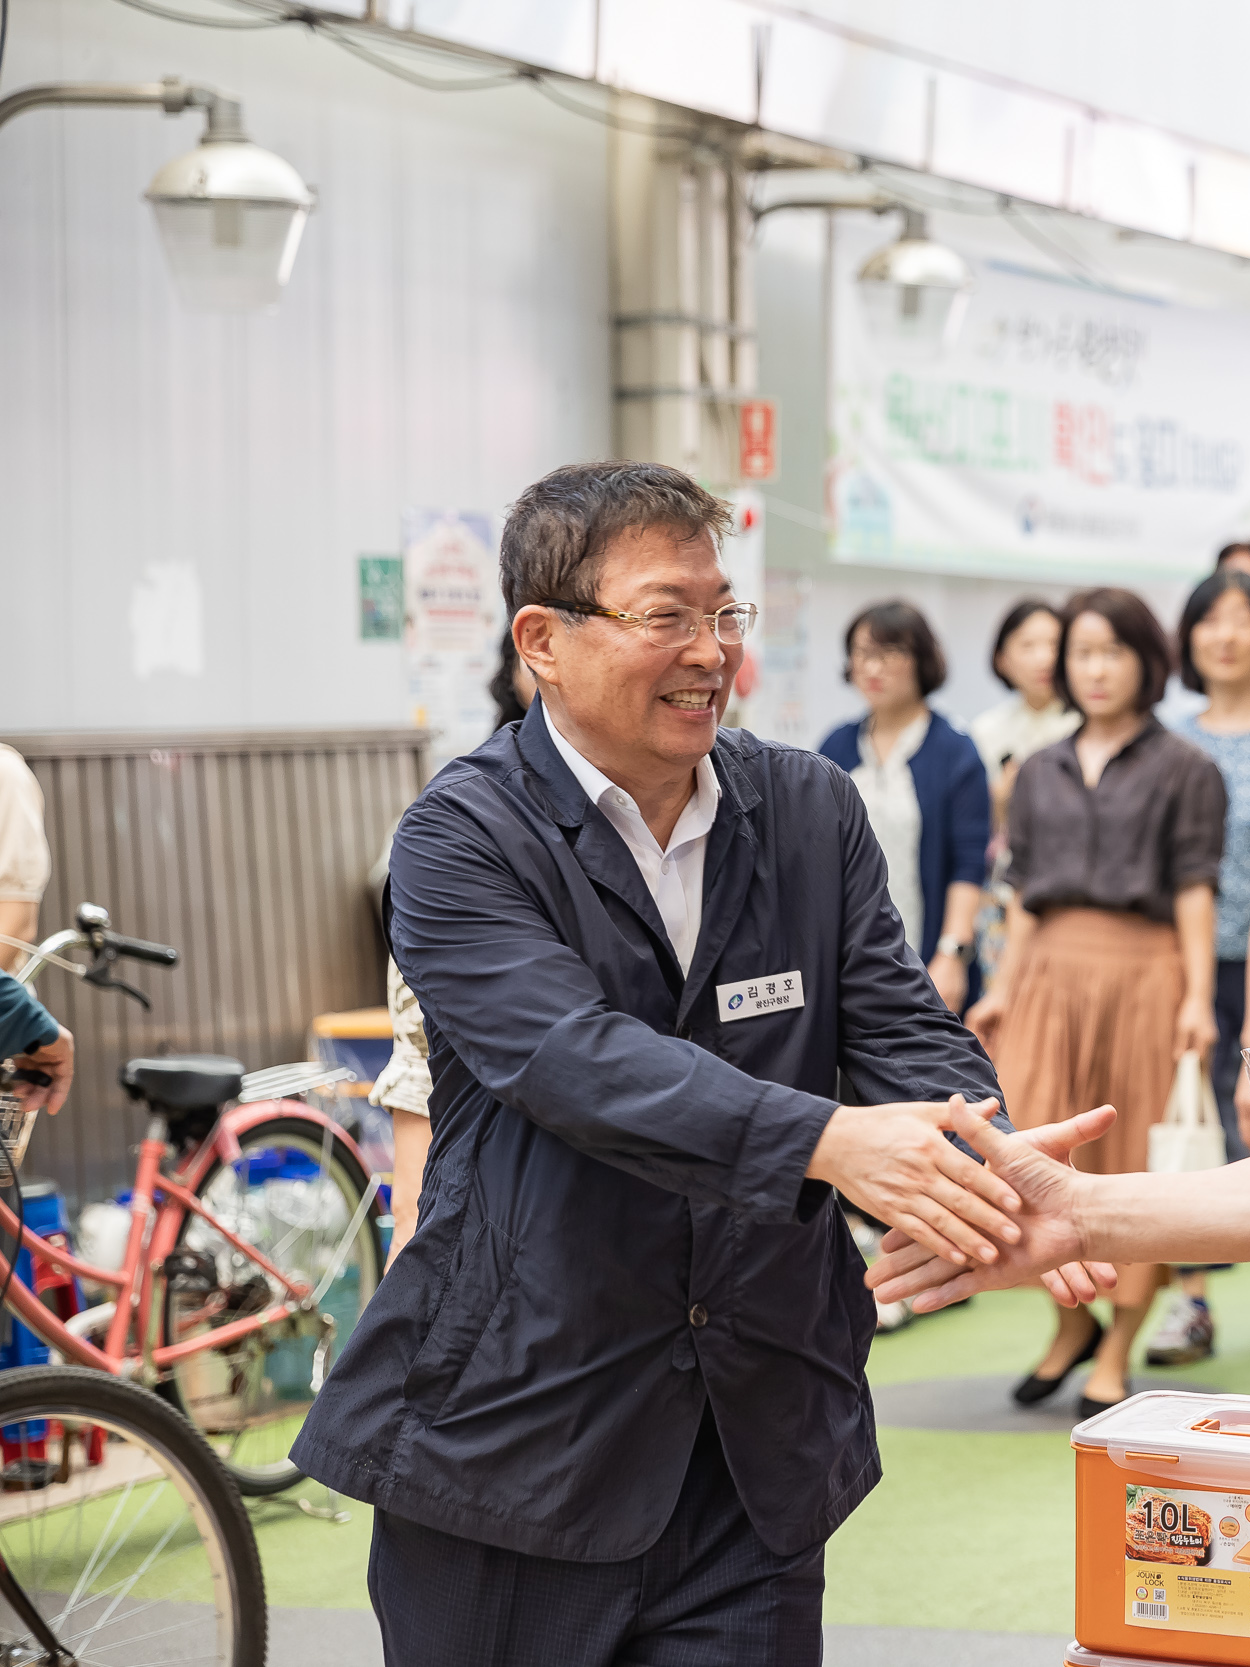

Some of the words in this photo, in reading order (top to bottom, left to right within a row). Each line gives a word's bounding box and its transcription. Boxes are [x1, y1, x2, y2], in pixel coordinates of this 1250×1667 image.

[755, 995, 790, 1009] 광진구청장
[1142, 1500, 1197, 1533] 10L
[1171, 1535, 1203, 1546] 진공누르미
[1144, 1579, 1165, 1587] LOCK
